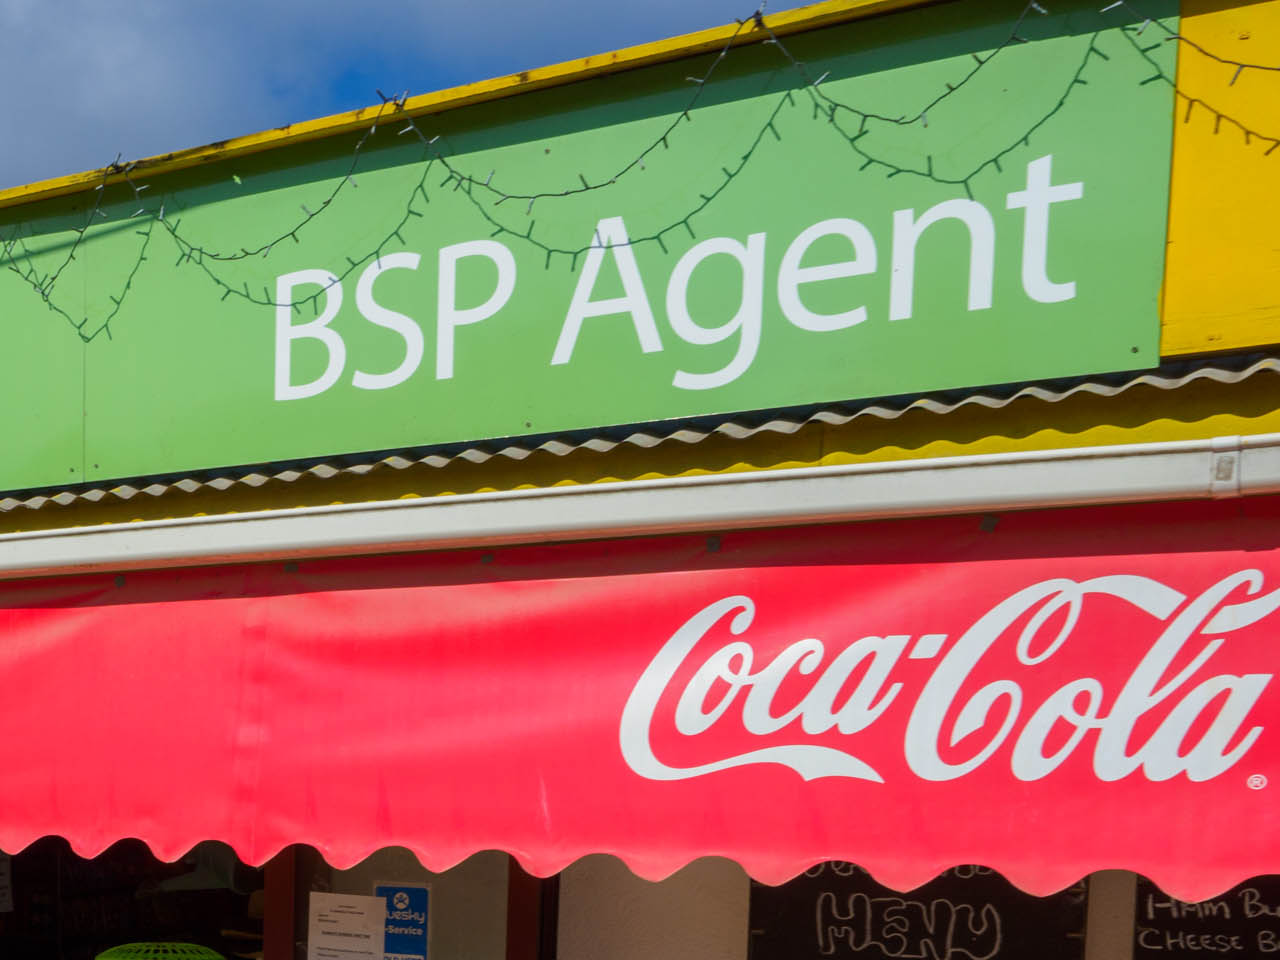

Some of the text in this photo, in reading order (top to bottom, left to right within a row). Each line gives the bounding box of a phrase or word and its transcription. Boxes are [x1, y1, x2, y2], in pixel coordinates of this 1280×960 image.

[274, 154, 1083, 401] BSP Agent
[619, 569, 1280, 783] Coca-Cola
[385, 911, 425, 924] uesky
[384, 925, 424, 936] -Service
[1138, 927, 1244, 951] CHEESE
